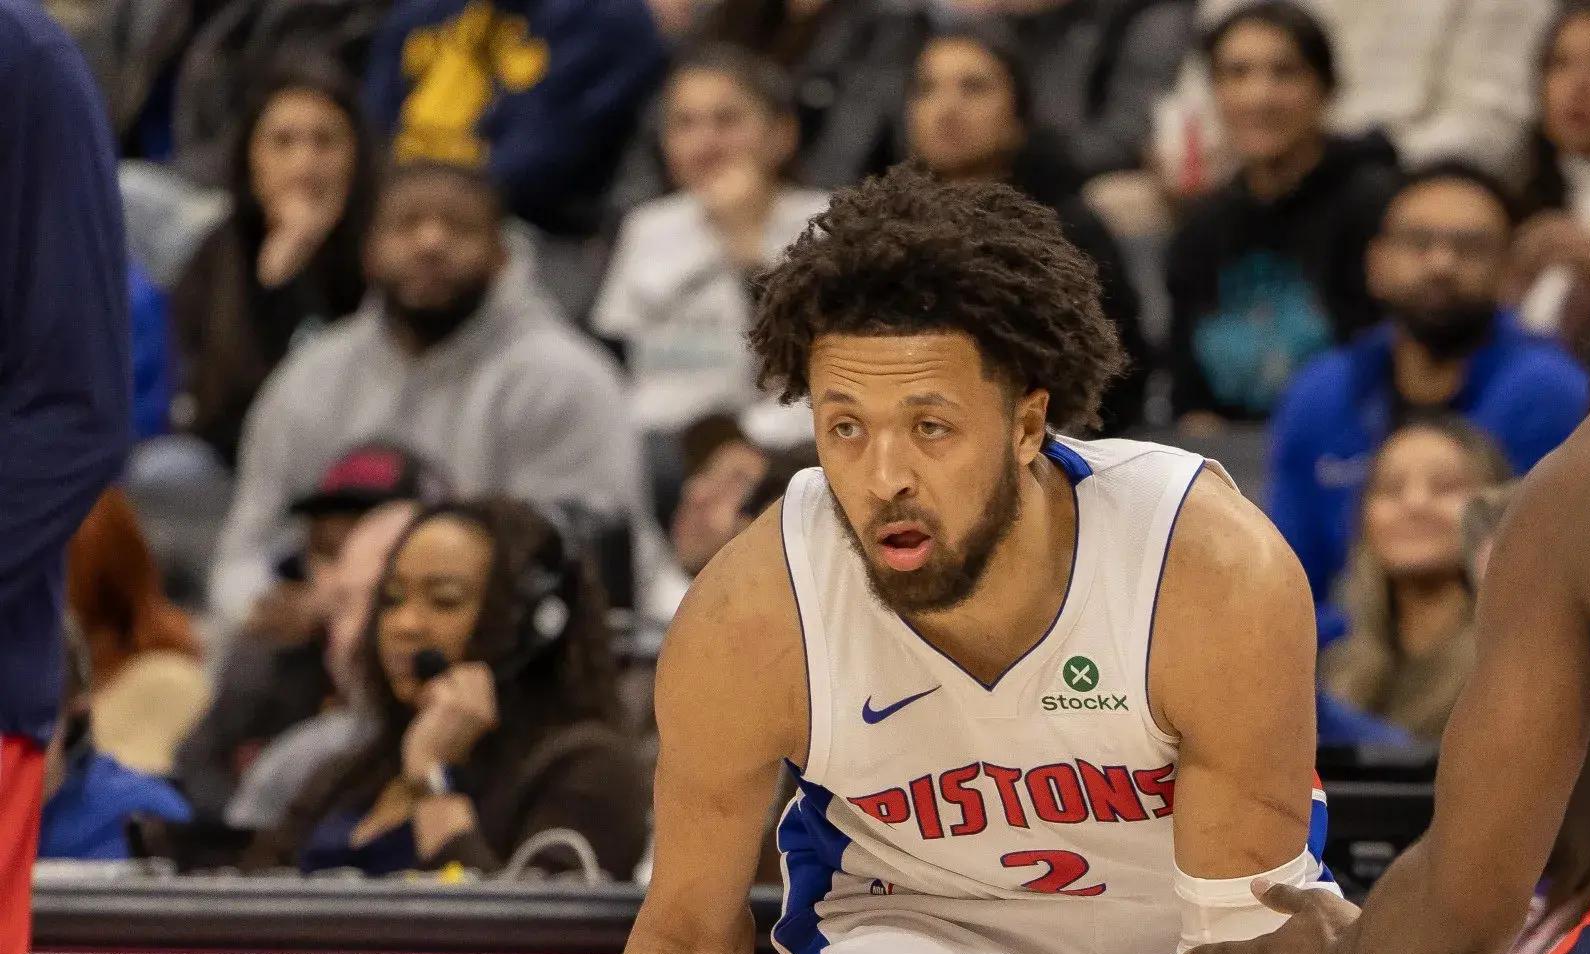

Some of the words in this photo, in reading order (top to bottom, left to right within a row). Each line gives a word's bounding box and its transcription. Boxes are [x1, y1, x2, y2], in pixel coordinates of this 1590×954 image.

[1041, 694, 1129, 712] StockX
[846, 758, 1175, 840] PISTONS
[1000, 849, 1107, 897] 2
